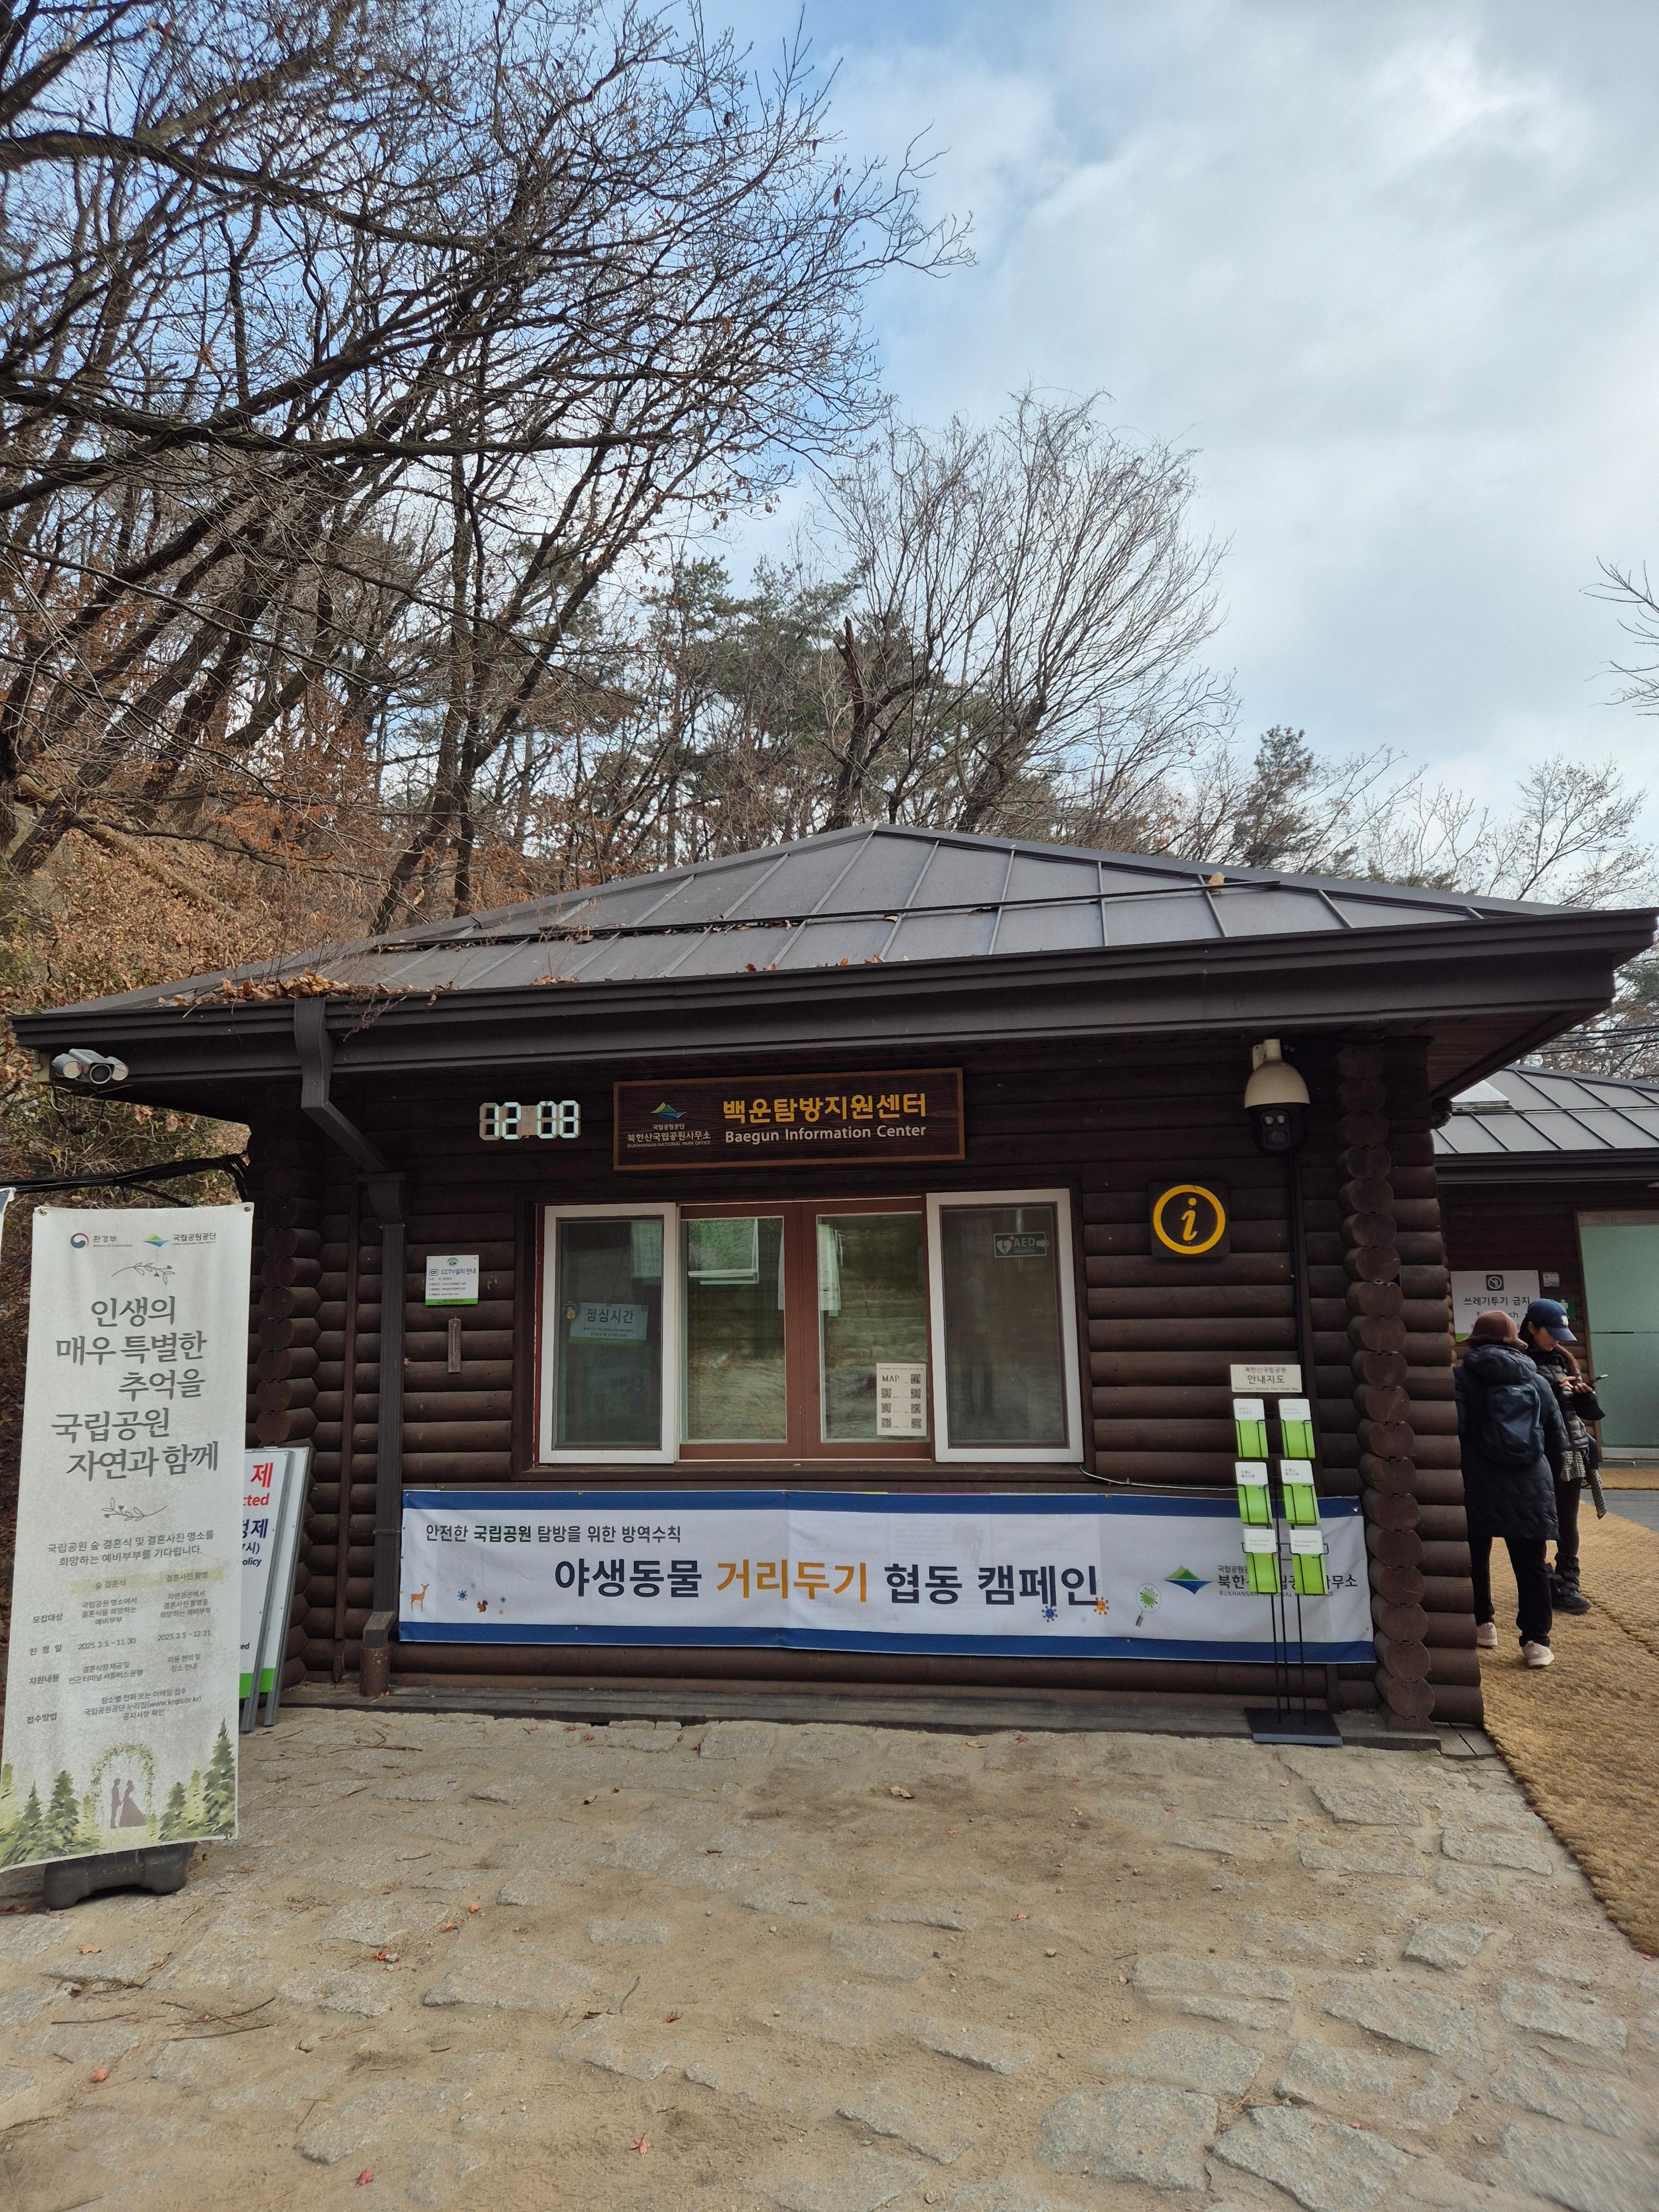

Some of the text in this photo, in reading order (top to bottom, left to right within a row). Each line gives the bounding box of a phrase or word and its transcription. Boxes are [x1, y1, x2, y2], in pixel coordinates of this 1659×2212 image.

[723, 1093, 926, 1124] 백운탐방지원센터
[627, 1130, 711, 1142] 북한산국립공원사무소
[725, 1124, 926, 1145] Baegun Information Center
[93, 1235, 117, 1243] 환경부
[173, 1232, 217, 1242] 국립공원공단
[1014, 1237, 1036, 1247] AED
[1464, 1296, 1530, 1306] 쓰레기투기 금지
[91, 1296, 176, 1327] 인생의
[586, 1308, 634, 1324] 점심시간
[56, 1330, 207, 1365] 매우 특별한
[118, 1368, 206, 1402] 추억을
[1248, 1375, 1285, 1384] 안내지도
[51, 1407, 170, 1443] 국립공원
[66, 1441, 219, 1481] 자연과 함께
[426, 1525, 681, 1543] 안전한 국립공원 탐방을 위한 방역수칙
[48, 1530, 214, 1553] 국립공원 숲 결혼식 및 결혼사진 명소를
[59, 1545, 202, 1567] 희망하는 예비부부를 기다립니다.
[242, 1558, 262, 1567] olicy
[105, 1579, 126, 1588] 결혼식
[555, 1558, 1100, 1606] 야생동물 거리두기 협동 캠페인
[32, 1613, 63, 1624] 모집대상
[29, 1673, 60, 1685] 지원내용
[153, 1688, 173, 1698] 이메일
[84, 1704, 126, 1716] 국립공원공단
[27, 1712, 58, 1724] 접수방법
